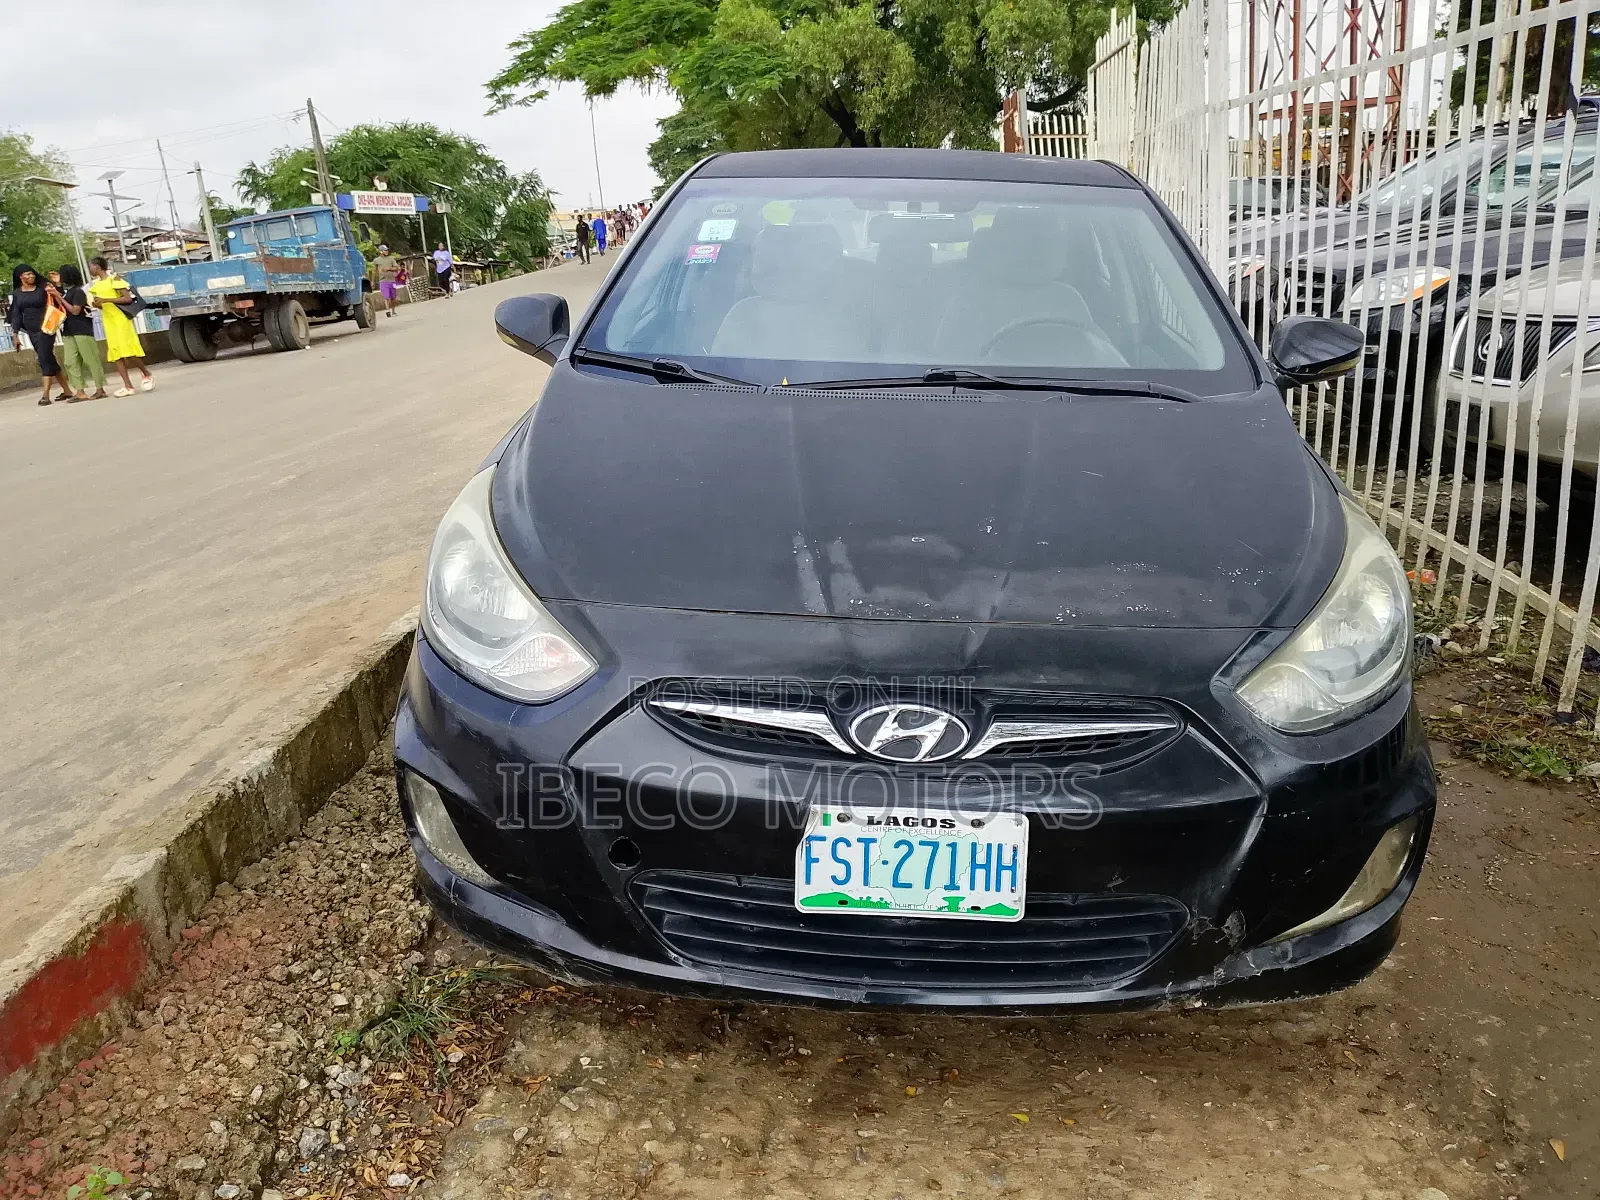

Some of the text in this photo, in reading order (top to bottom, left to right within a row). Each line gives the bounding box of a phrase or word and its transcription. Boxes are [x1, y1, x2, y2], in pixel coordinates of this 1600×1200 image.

[375, 195, 397, 206] MEMORIAL
[397, 196, 412, 207] ARCADE
[866, 815, 956, 829] LAGOS
[908, 827, 962, 837] EXCELLENCE
